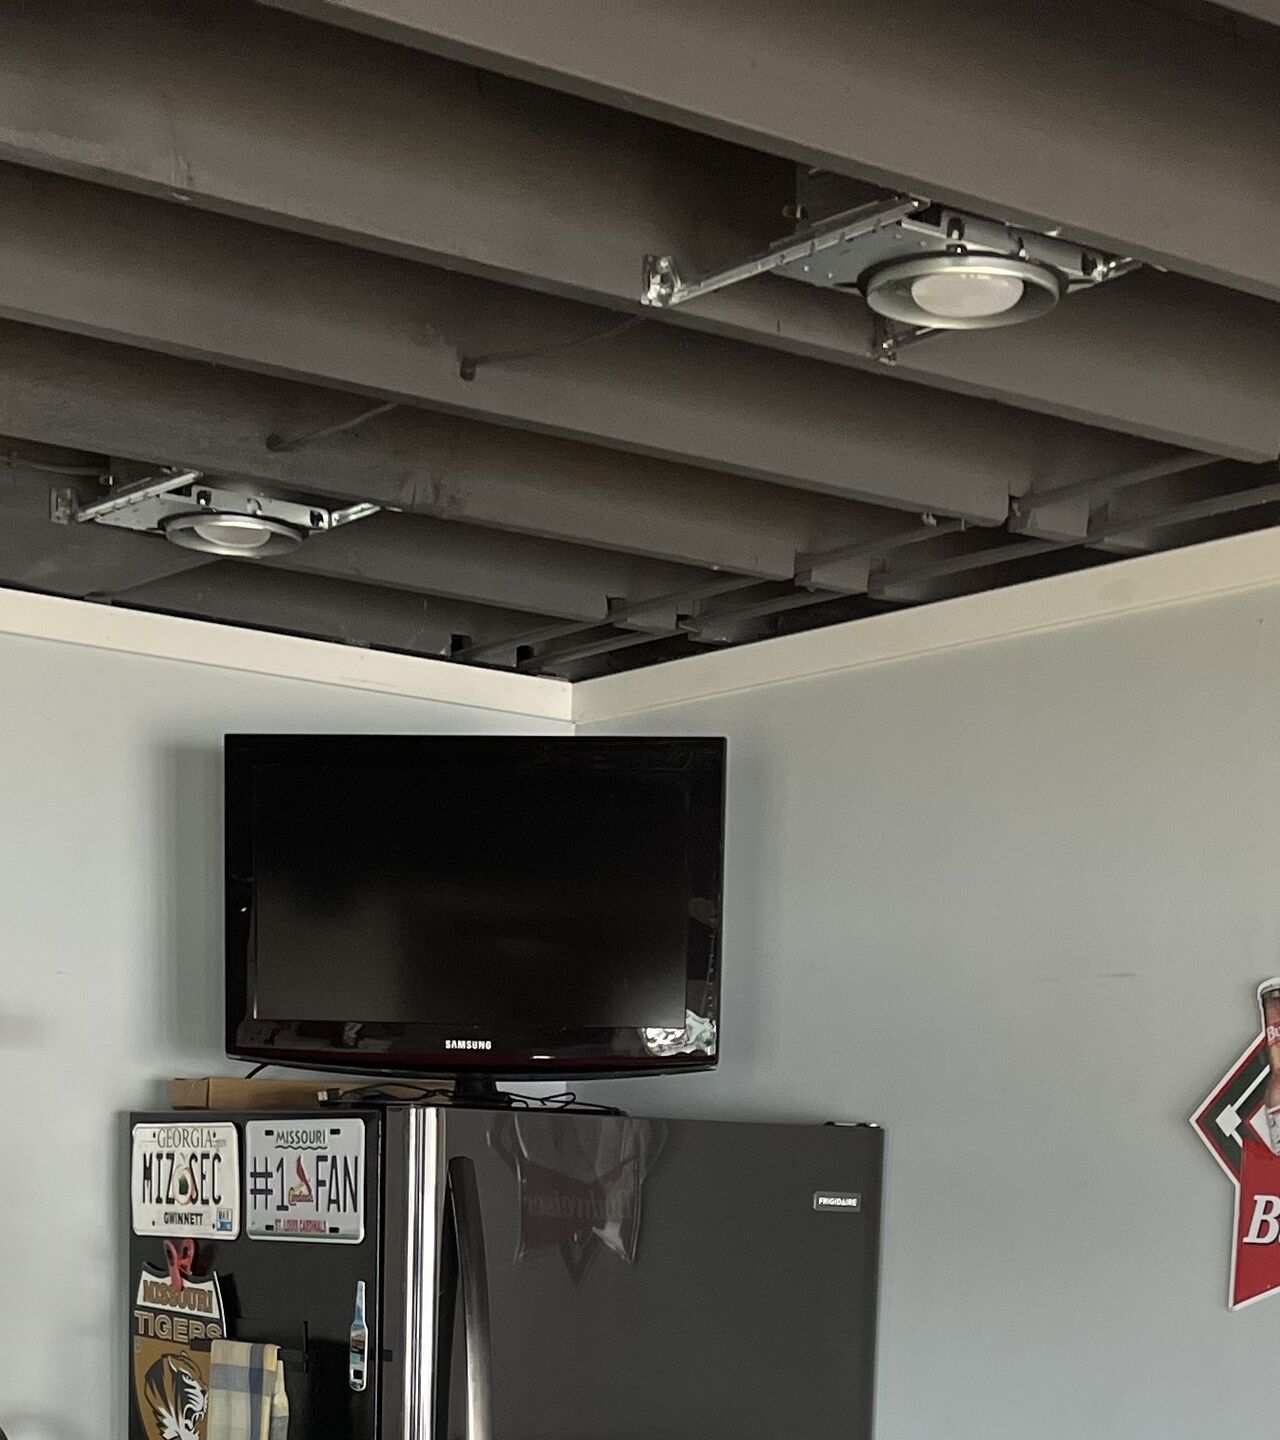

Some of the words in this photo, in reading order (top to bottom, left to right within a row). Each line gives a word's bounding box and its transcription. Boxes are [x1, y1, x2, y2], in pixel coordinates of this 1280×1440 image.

[445, 1039, 492, 1050] SAMSUNG
[157, 1128, 213, 1148] GEORGIA
[275, 1129, 326, 1145] MISSOURI
[142, 1152, 175, 1204] MIZ
[189, 1152, 222, 1205] SEC
[250, 1156, 289, 1211] #1
[315, 1155, 359, 1213] FAN
[818, 1197, 858, 1207] FRIGIDAIRE
[163, 1212, 203, 1226] GWINNETT
[142, 1280, 213, 1314] MISSOURI
[134, 1310, 223, 1345] TIGERS
